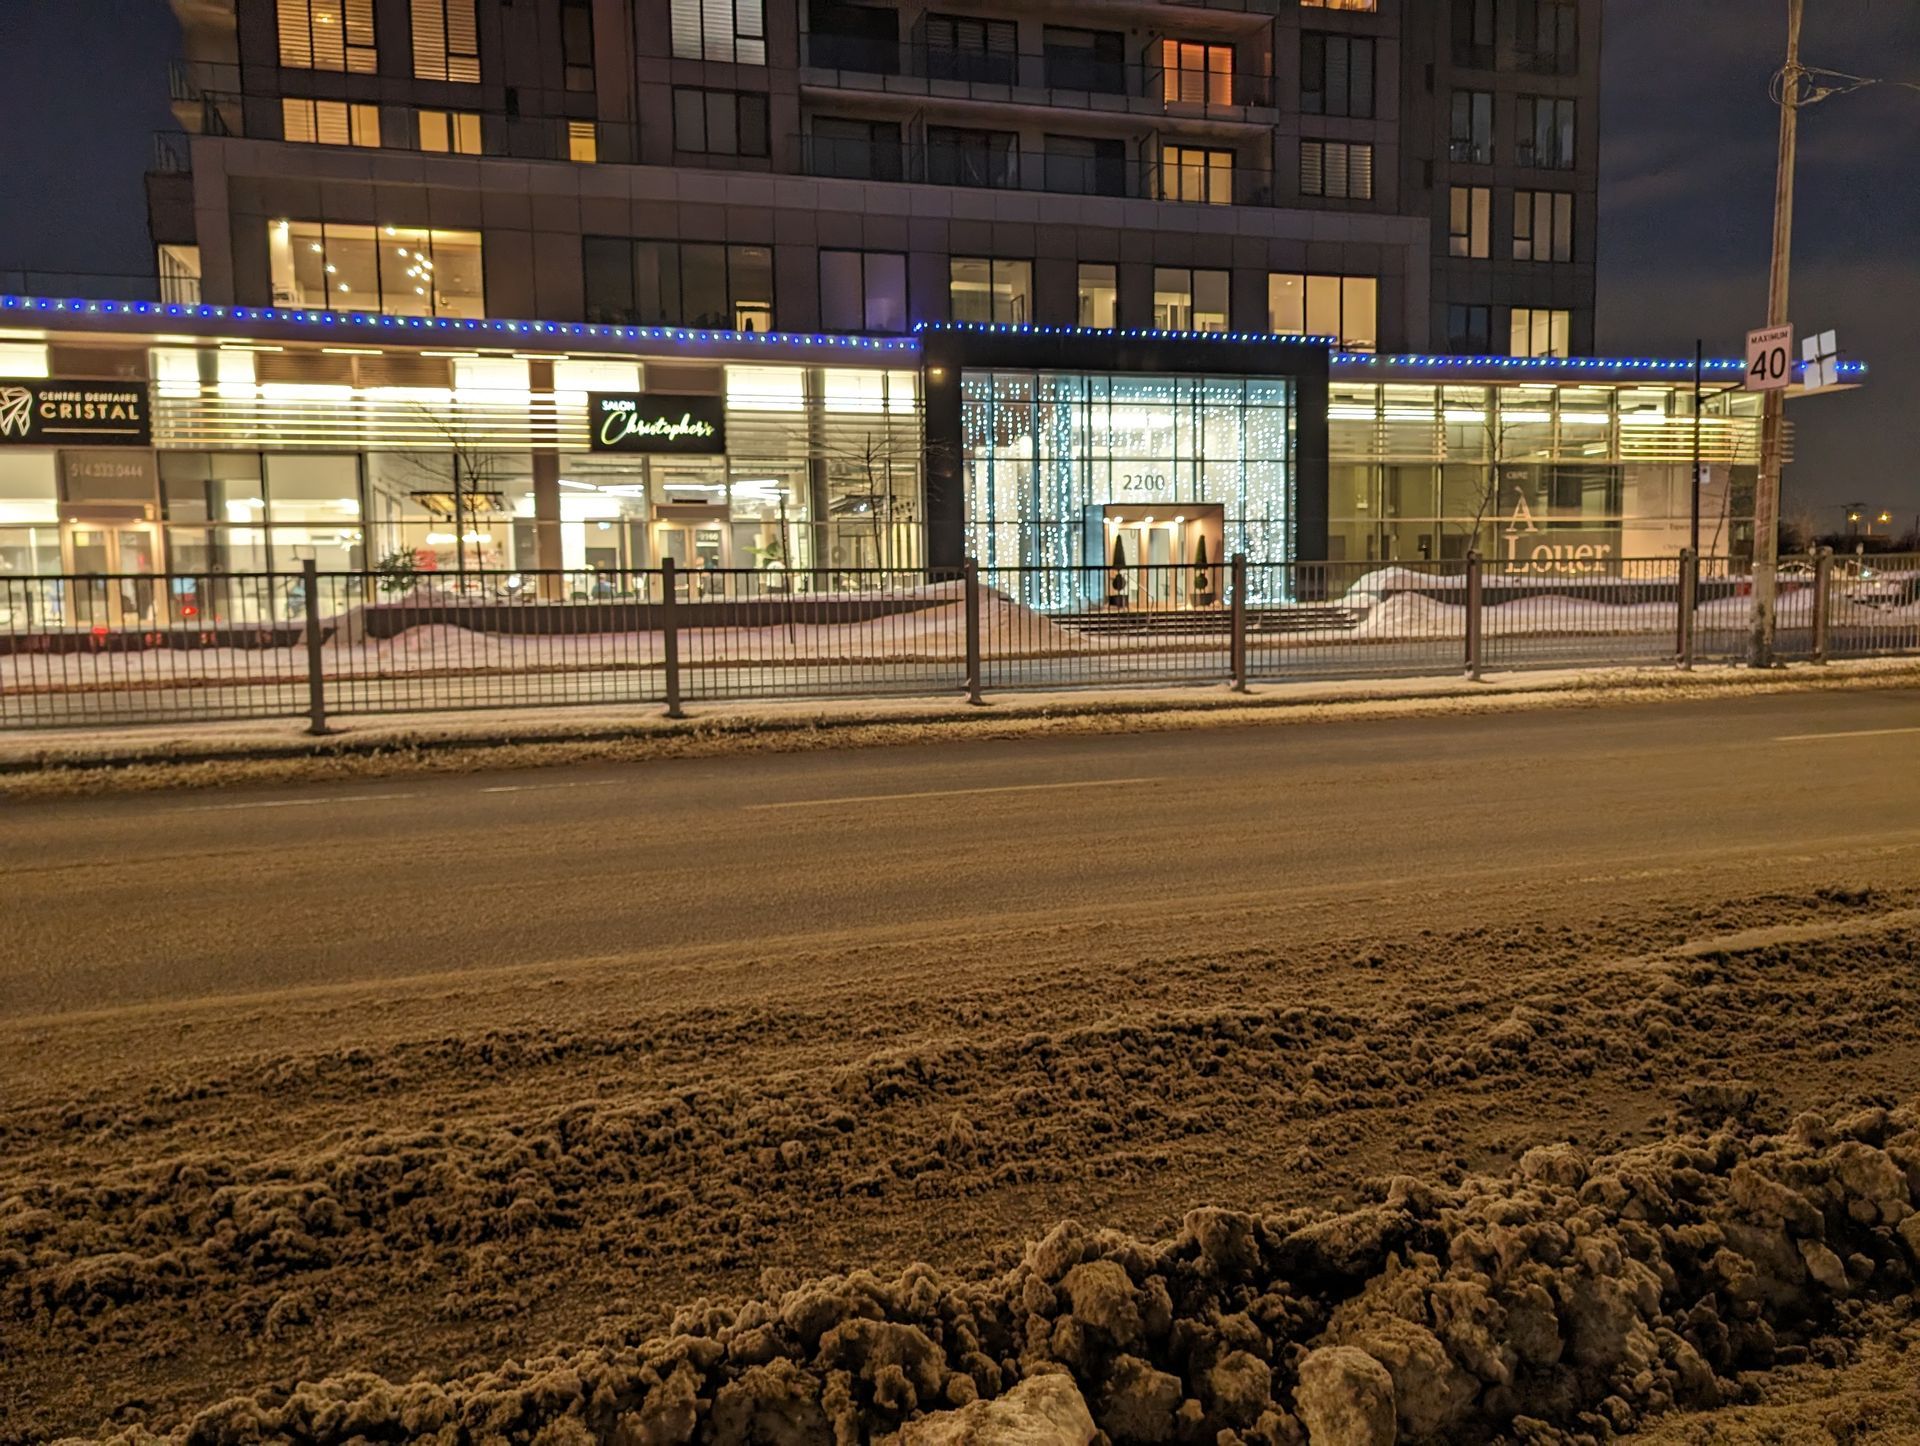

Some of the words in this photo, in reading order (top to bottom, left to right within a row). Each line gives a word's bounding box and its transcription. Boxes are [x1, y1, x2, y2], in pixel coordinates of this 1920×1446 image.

[1751, 331, 1788, 344] MAXIMUM
[1750, 347, 1786, 380] 40
[39, 391, 81, 401] CENTRE
[40, 402, 139, 420] CRISTAL
[601, 400, 636, 411] SALON
[1123, 474, 1165, 491] 2200
[1504, 535, 1610, 573] Louer
